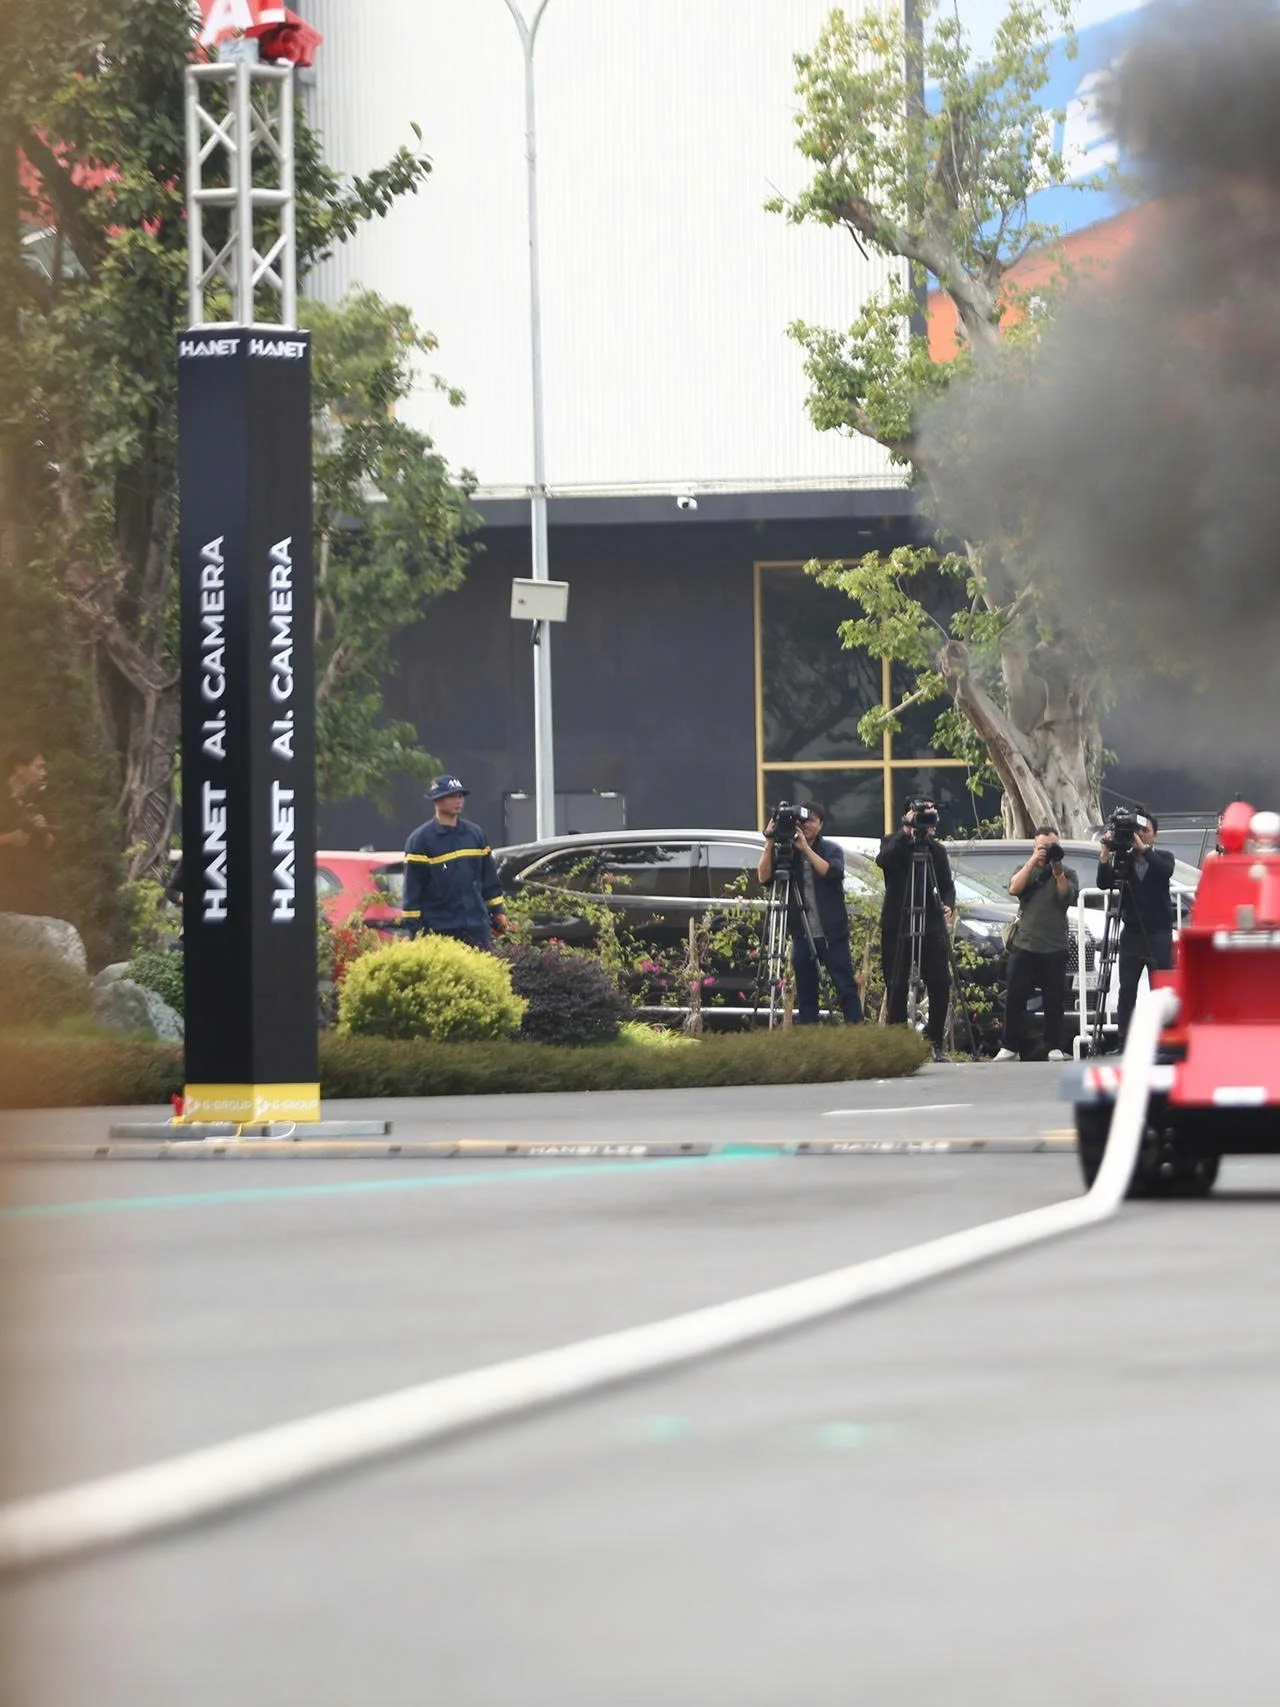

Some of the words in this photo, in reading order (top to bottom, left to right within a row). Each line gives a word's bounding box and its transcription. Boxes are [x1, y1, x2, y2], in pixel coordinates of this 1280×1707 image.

[180, 339, 240, 357] HANET
[249, 338, 307, 357] HANET
[201, 535, 226, 701] CAMERA
[268, 535, 293, 702] CAMERA
[203, 780, 227, 922] HANET
[271, 780, 295, 922] HANET
